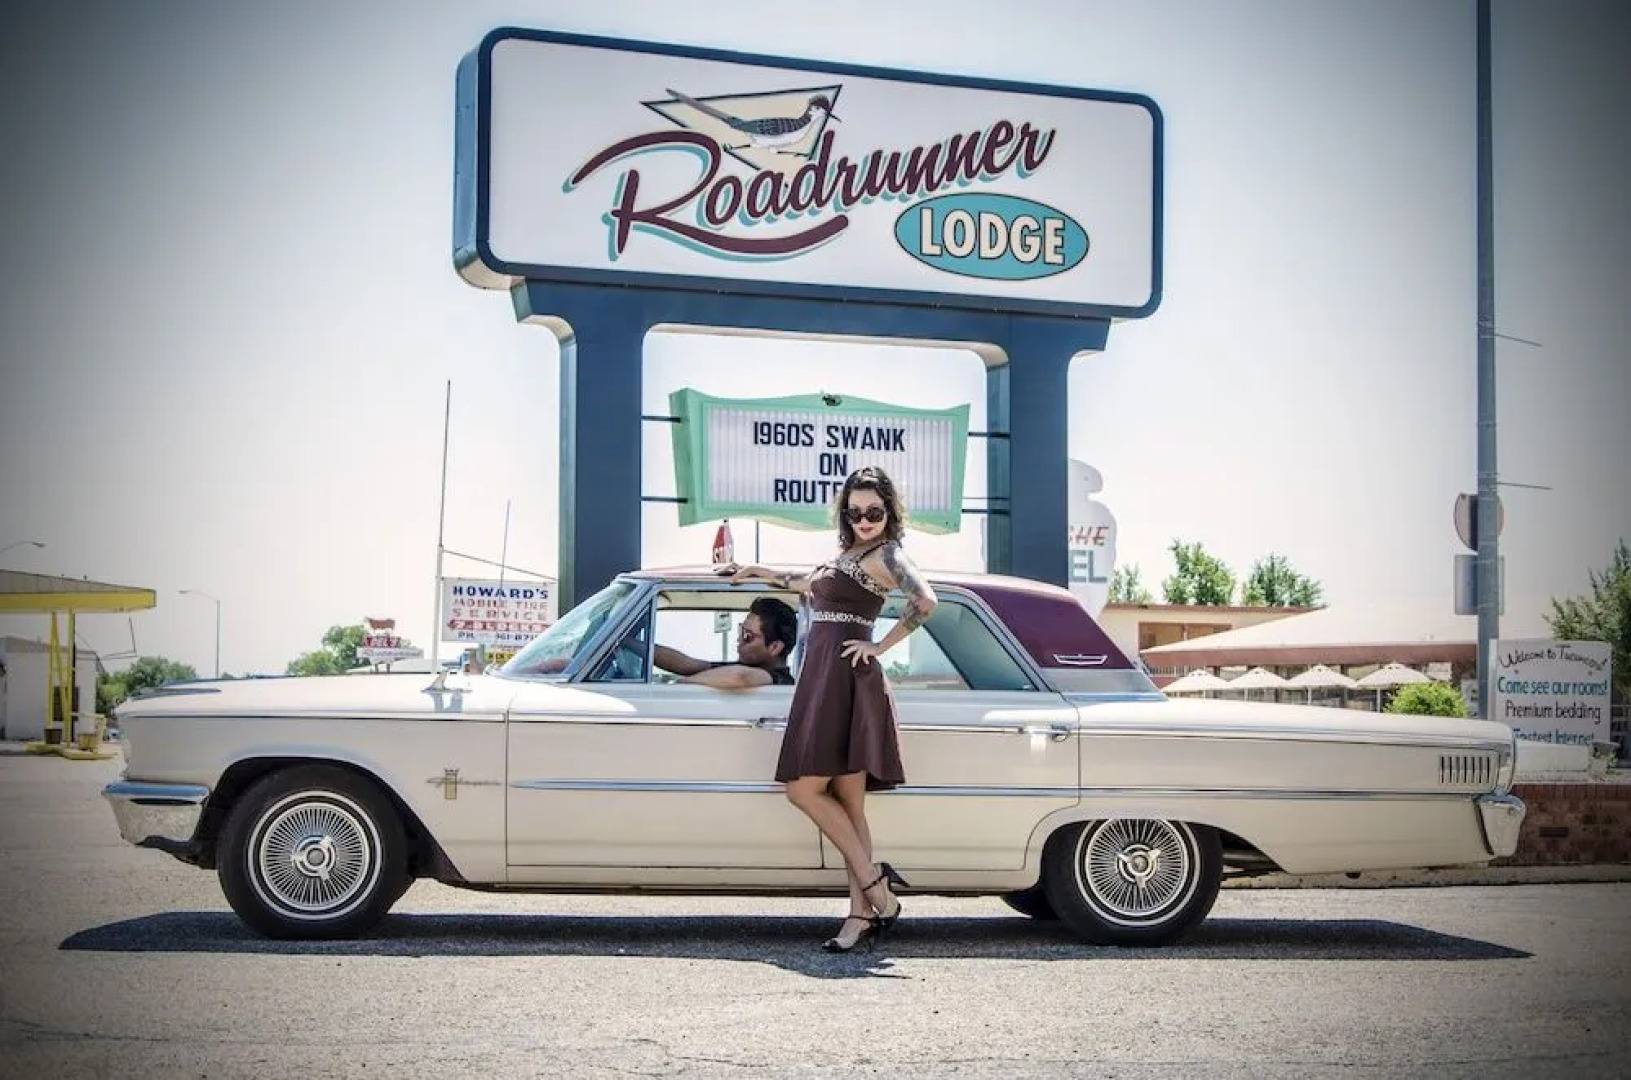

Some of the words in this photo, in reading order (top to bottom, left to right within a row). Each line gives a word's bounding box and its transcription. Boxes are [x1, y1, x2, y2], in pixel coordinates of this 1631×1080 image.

[564, 120, 1056, 260] Roadrunner
[919, 207, 1067, 267] LODGE
[753, 421, 815, 448] 1960S
[825, 425, 906, 452] SWANK
[818, 453, 848, 476] ON
[1070, 525, 1110, 547] HE
[452, 585, 549, 600] HOWARD'S
[454, 598, 508, 609] MOBILE
[451, 608, 547, 622] SERVICE
[1546, 648, 1557, 660] to
[1498, 676, 1529, 694] Come
[1530, 681, 1550, 695] see
[1552, 681, 1571, 695] our
[1572, 680, 1608, 696] rooms!
[1505, 699, 1552, 718] Premium
[1555, 700, 1601, 725] bedding
